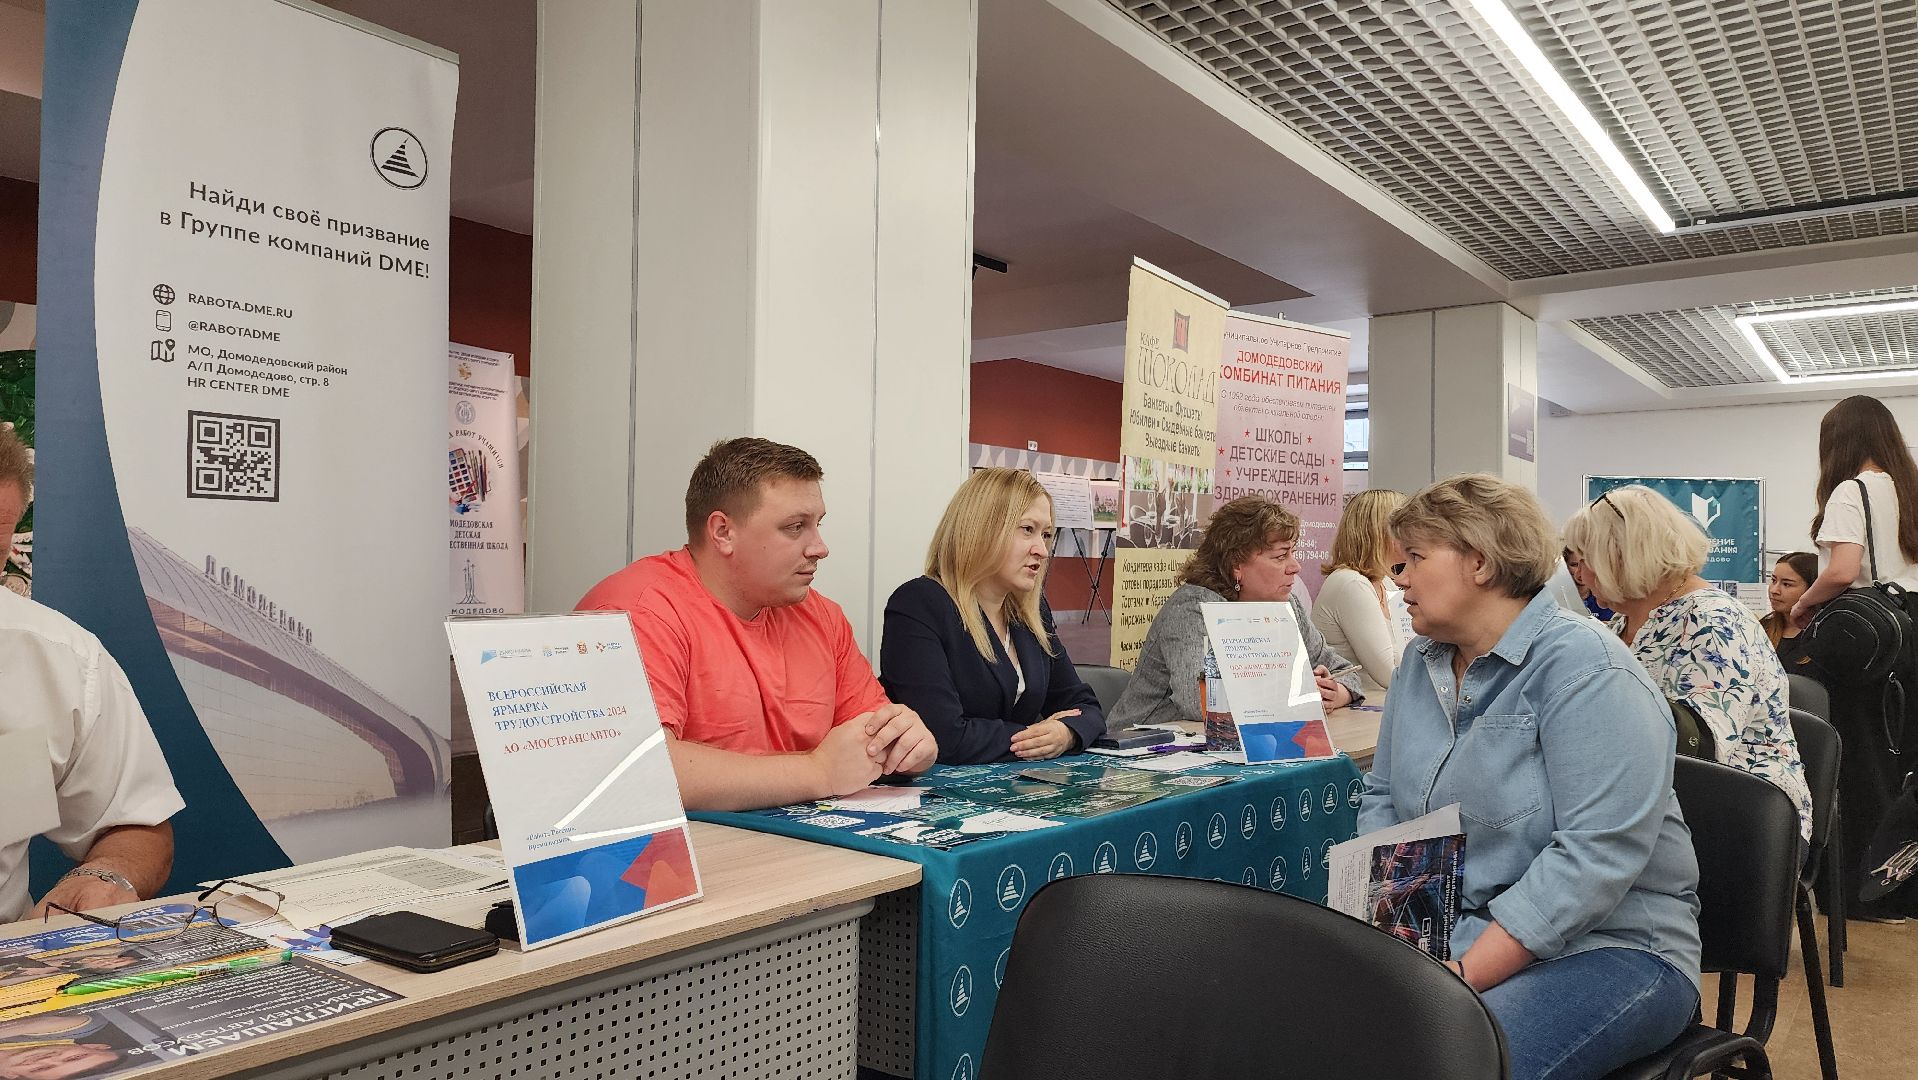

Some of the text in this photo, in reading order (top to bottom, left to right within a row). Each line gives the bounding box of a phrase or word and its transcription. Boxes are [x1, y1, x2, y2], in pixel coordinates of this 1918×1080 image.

[189, 181, 430, 251] Найди своё призвание
[160, 211, 430, 278] в Группе компаний DME!
[188, 293, 293, 318] RABOTA.DME.RU
[188, 320, 281, 342] @RABOTADME
[188, 344, 348, 376] МО, Домодедовский район
[1237, 350, 1323, 374] ДОМОДЕДОВСКИЙ
[187, 360, 330, 387] А/П Домодедово, стр. 8
[1138, 346, 1216, 407] ШОКОЛАД
[1287, 374, 1341, 395] ПИТАНИЯ
[187, 376, 290, 398] HR CENTER DME
[1255, 428, 1302, 445] ШКОЛЫ
[1230, 445, 1325, 469] ДЕТСКИЕ САДЫ
[1236, 466, 1319, 486] УЧРЕЖДЕНИЯ
[454, 530, 481, 539] ДЕТСКАЯ
[486, 542, 509, 550] ШКОЛА
[487, 681, 588, 701] ВСЕРОССИЙСКАЯ
[492, 701, 549, 717] ЯРМАРКА
[495, 705, 627, 731] ТРУДОУСТРОЙСТВА 2024
[503, 728, 622, 754] АО «МОСТРАНСАВТО»
[127, 987, 377, 1056] ВОДИТЕЛЕЙ АВТОБУСОВ
[168, 991, 393, 1056] ПРИГЛАШАЕМ
